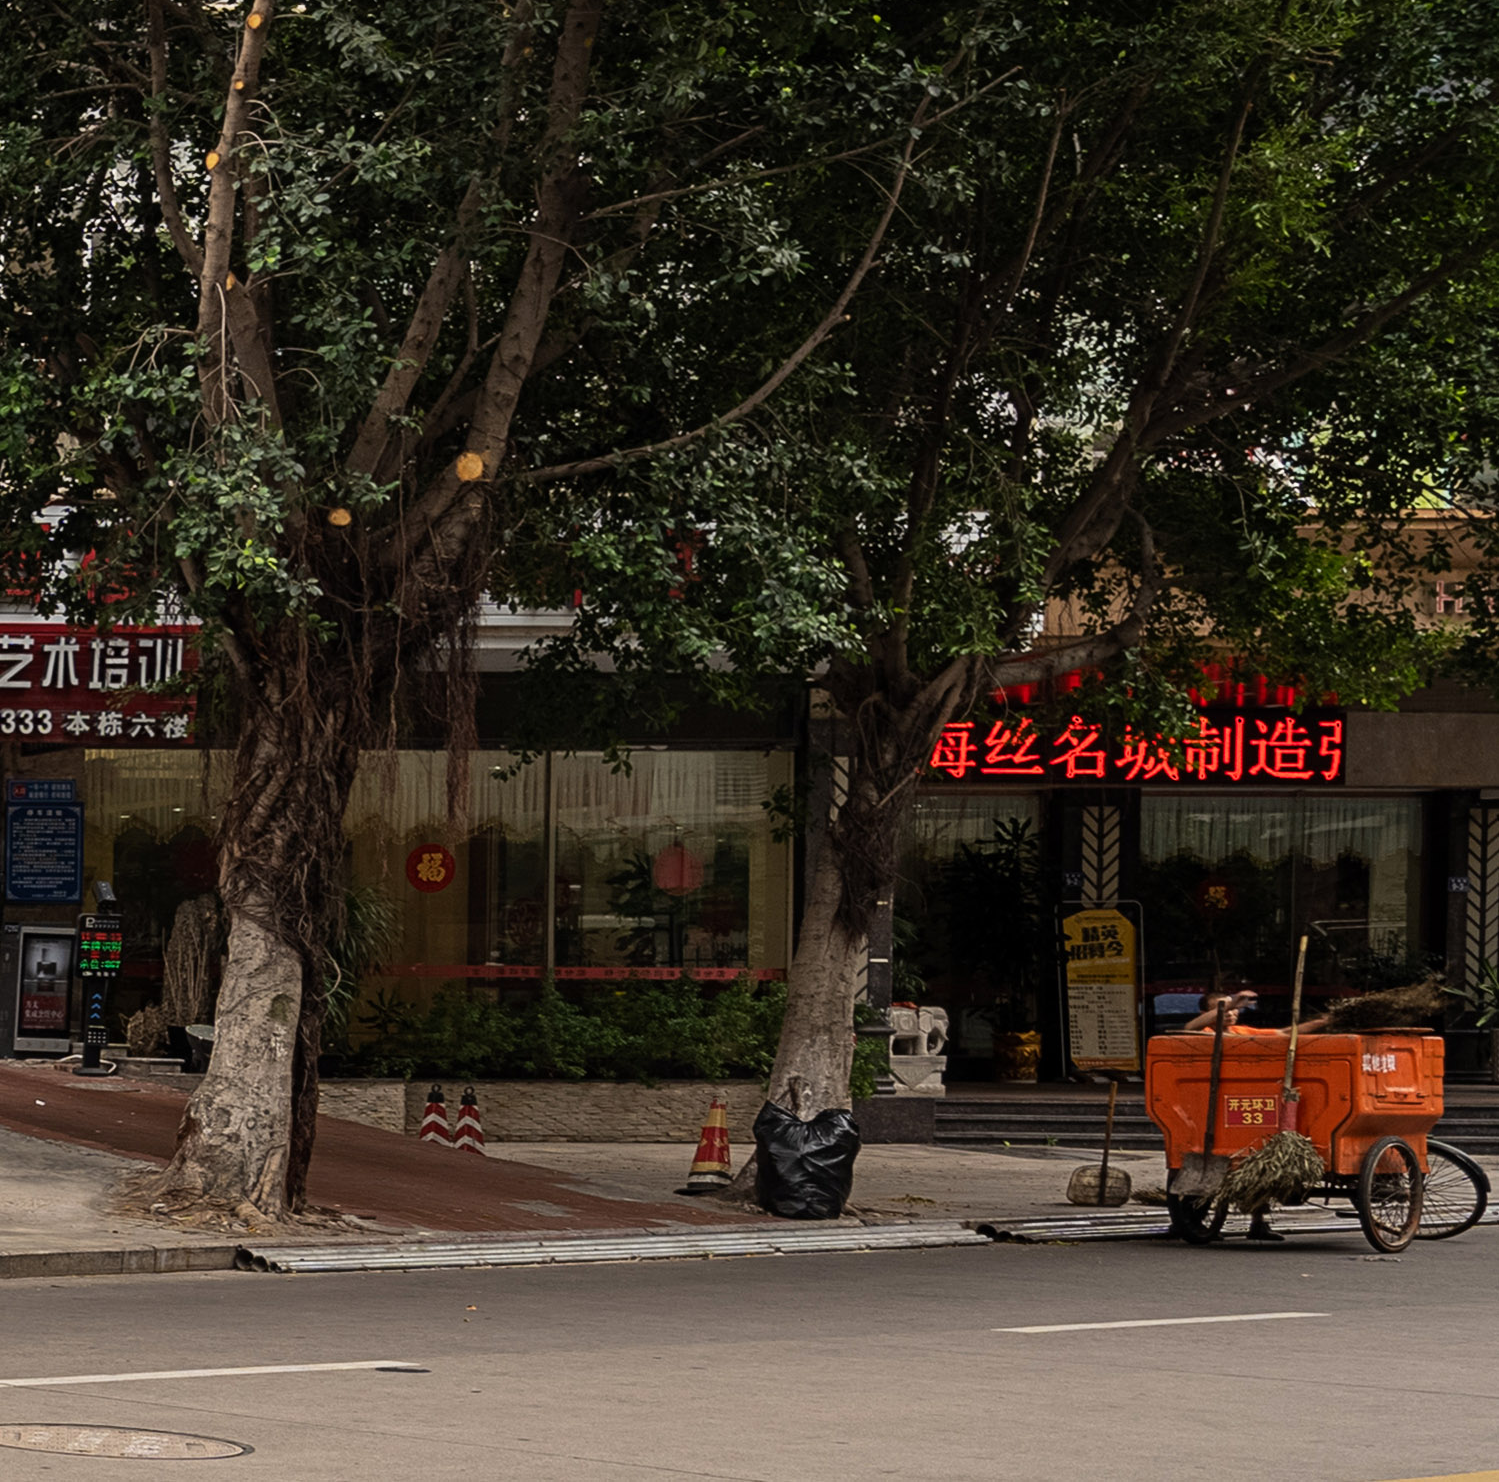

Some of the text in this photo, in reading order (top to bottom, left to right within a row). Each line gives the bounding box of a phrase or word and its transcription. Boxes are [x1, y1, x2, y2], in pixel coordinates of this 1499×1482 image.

[420, 852, 446, 883] 福
[1228, 1099, 1276, 1111] 开元环卫
[1242, 1113, 1263, 1124] 33
